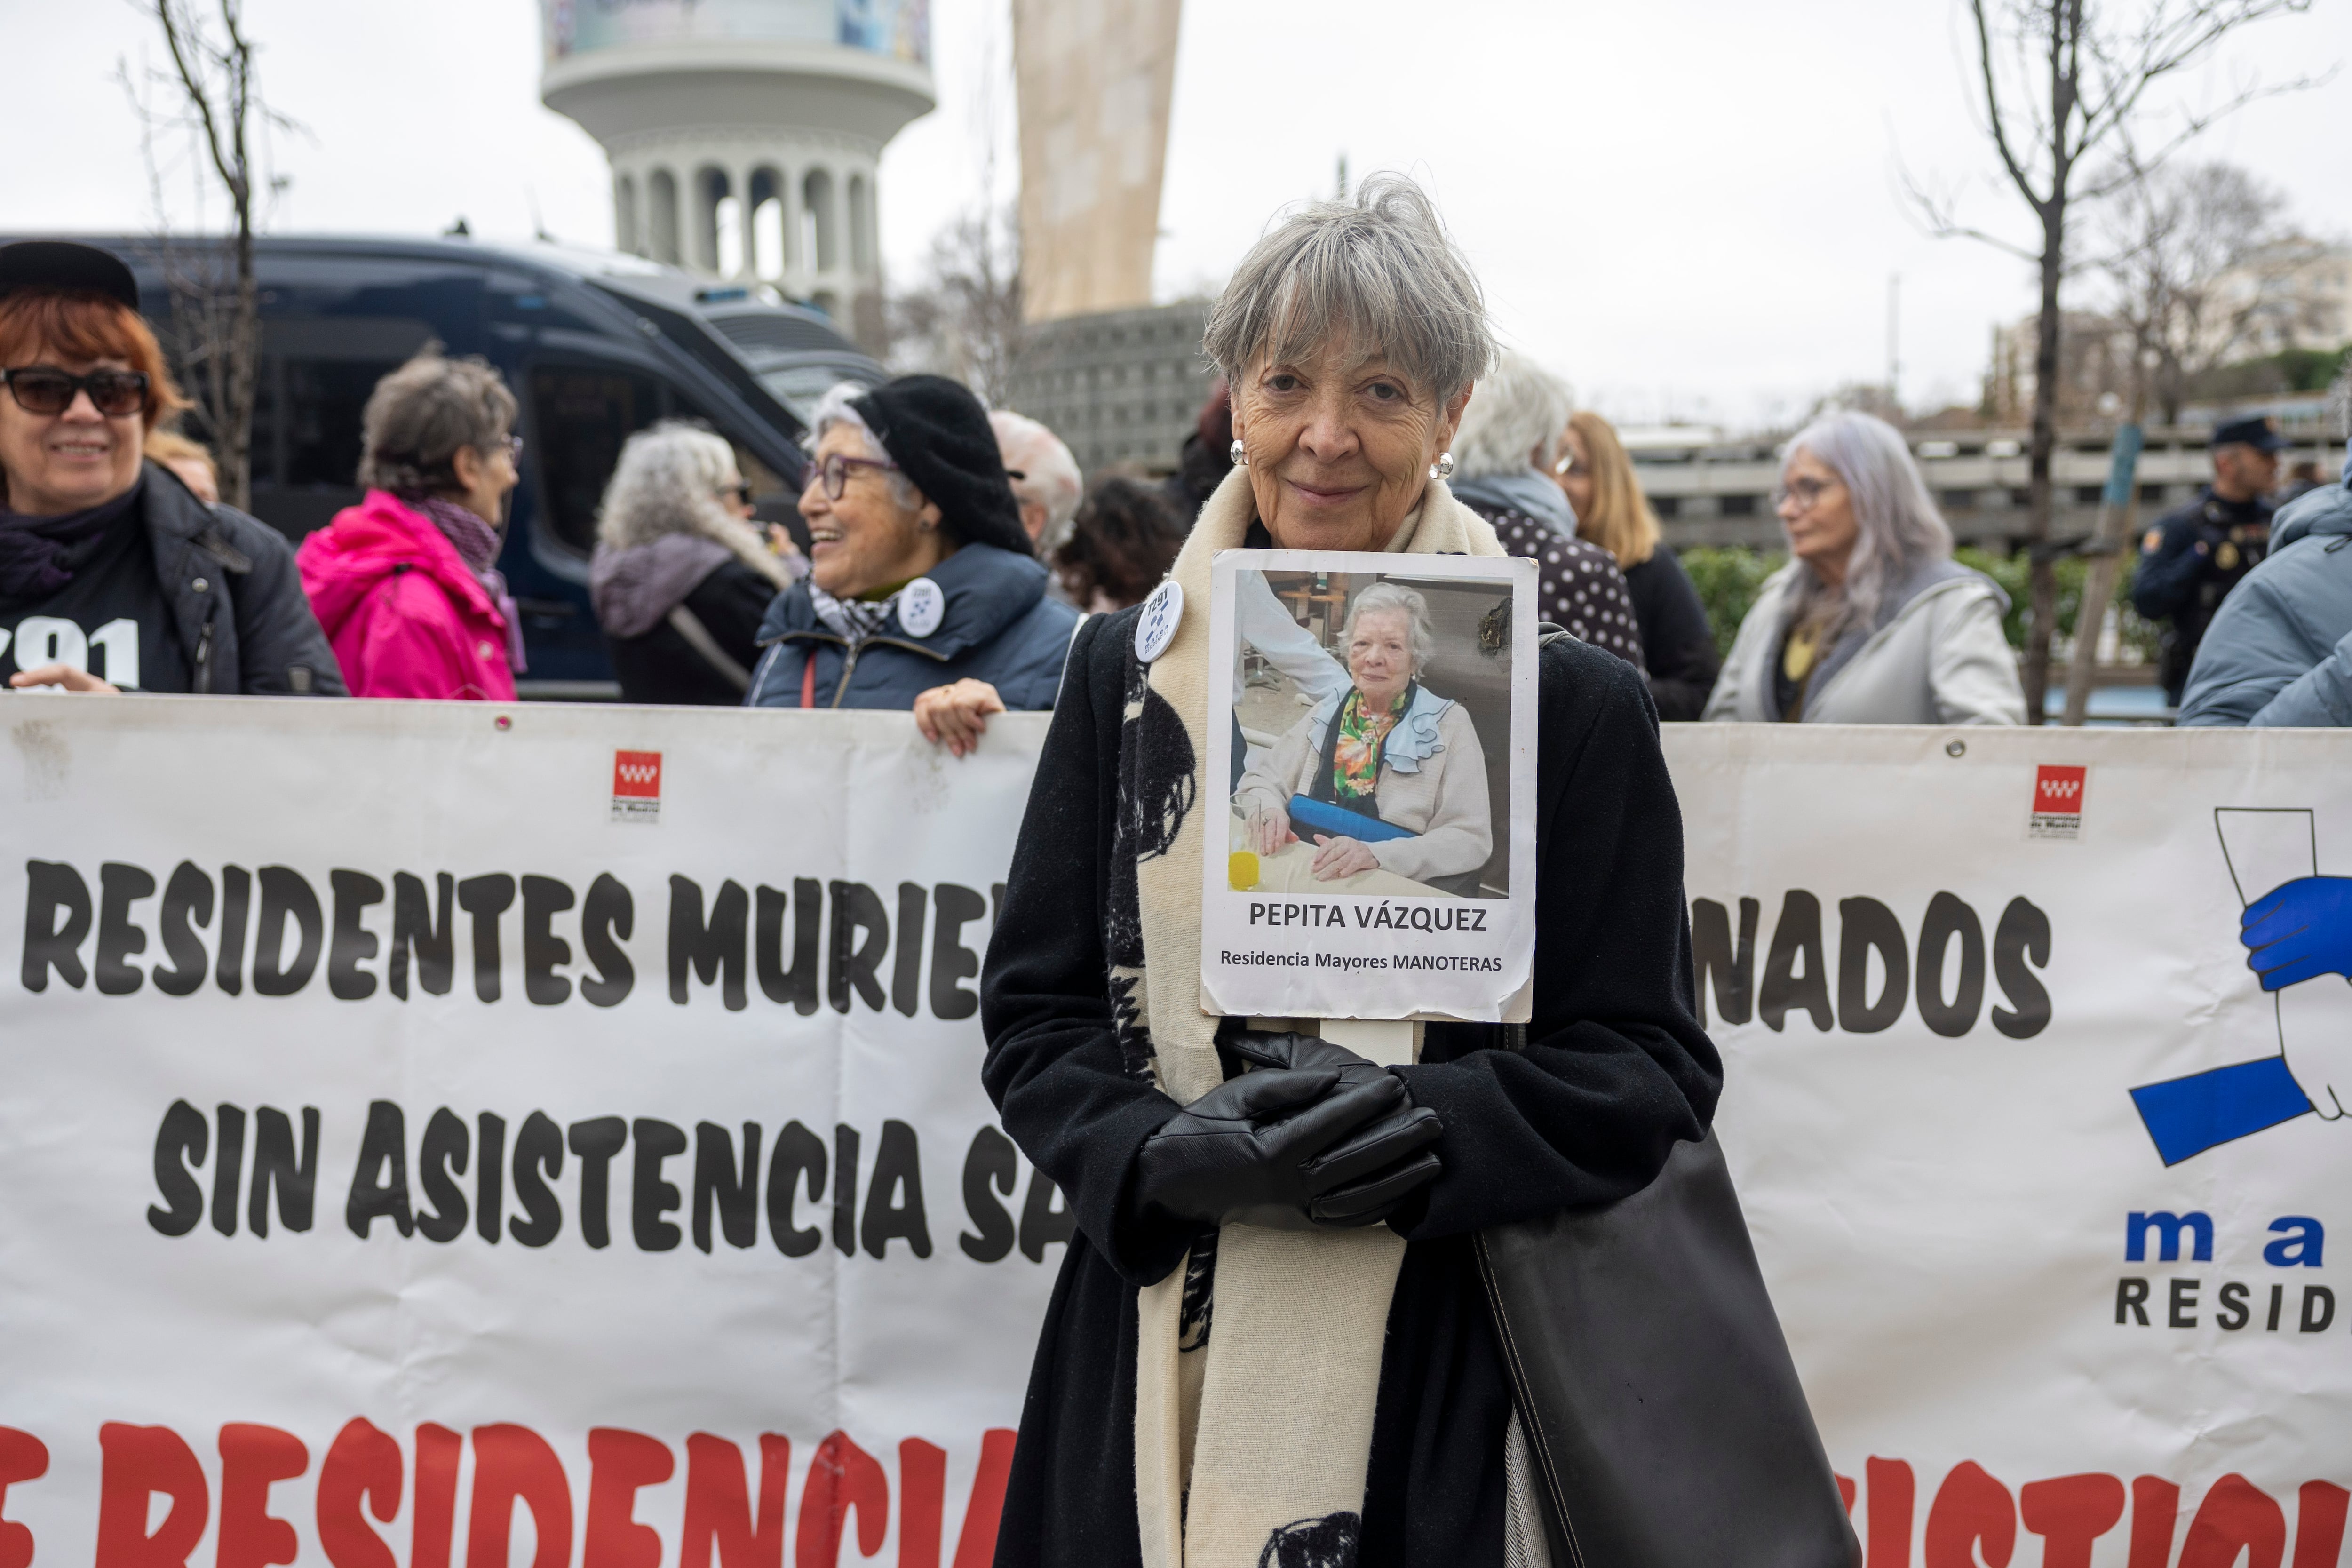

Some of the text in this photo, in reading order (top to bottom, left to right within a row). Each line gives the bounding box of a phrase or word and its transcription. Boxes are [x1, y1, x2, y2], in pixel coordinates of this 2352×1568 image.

[1148, 587, 1168, 617] 7291
[0, 615, 140, 694] 91
[1145, 629, 1169, 655] RESIDENCIAS
[1250, 900, 1487, 933] PEPITA VÁZQUEZ
[22, 859, 635, 1007] RESIDENTES
[667, 873, 1007, 1021] MURIE
[1221, 950, 1502, 971] Residencia Mayores MANOTERAS
[147, 1098, 320, 1240] SIN
[345, 1099, 933, 1261] ASISTENCIA
